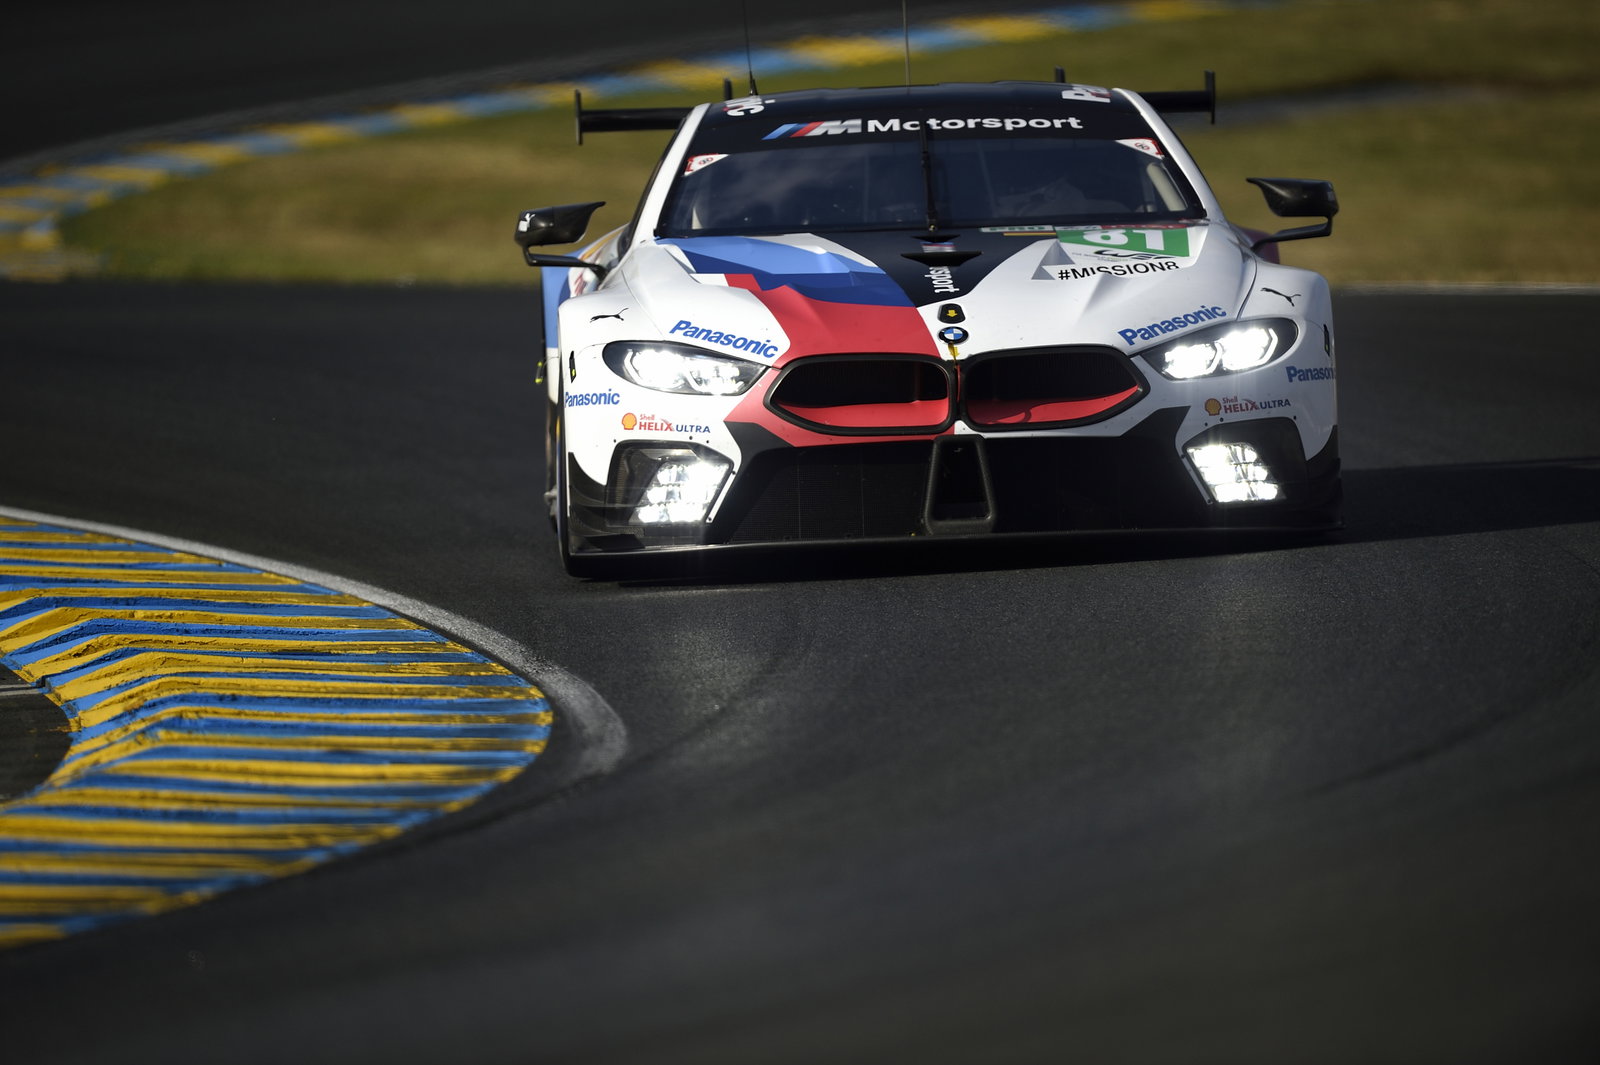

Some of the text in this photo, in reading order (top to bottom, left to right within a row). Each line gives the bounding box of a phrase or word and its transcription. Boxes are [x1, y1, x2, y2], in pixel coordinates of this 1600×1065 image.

[868, 117, 1083, 132] Motorsport
[1058, 261, 1179, 280] #MISSION8
[1118, 305, 1227, 346] Panasonic
[669, 320, 779, 358] Panasonic
[565, 388, 620, 408] Panasonic
[1222, 396, 1238, 404] Shell
[1224, 399, 1291, 413] HELIX ULTRA
[639, 421, 711, 433] HELIX ULTRA
